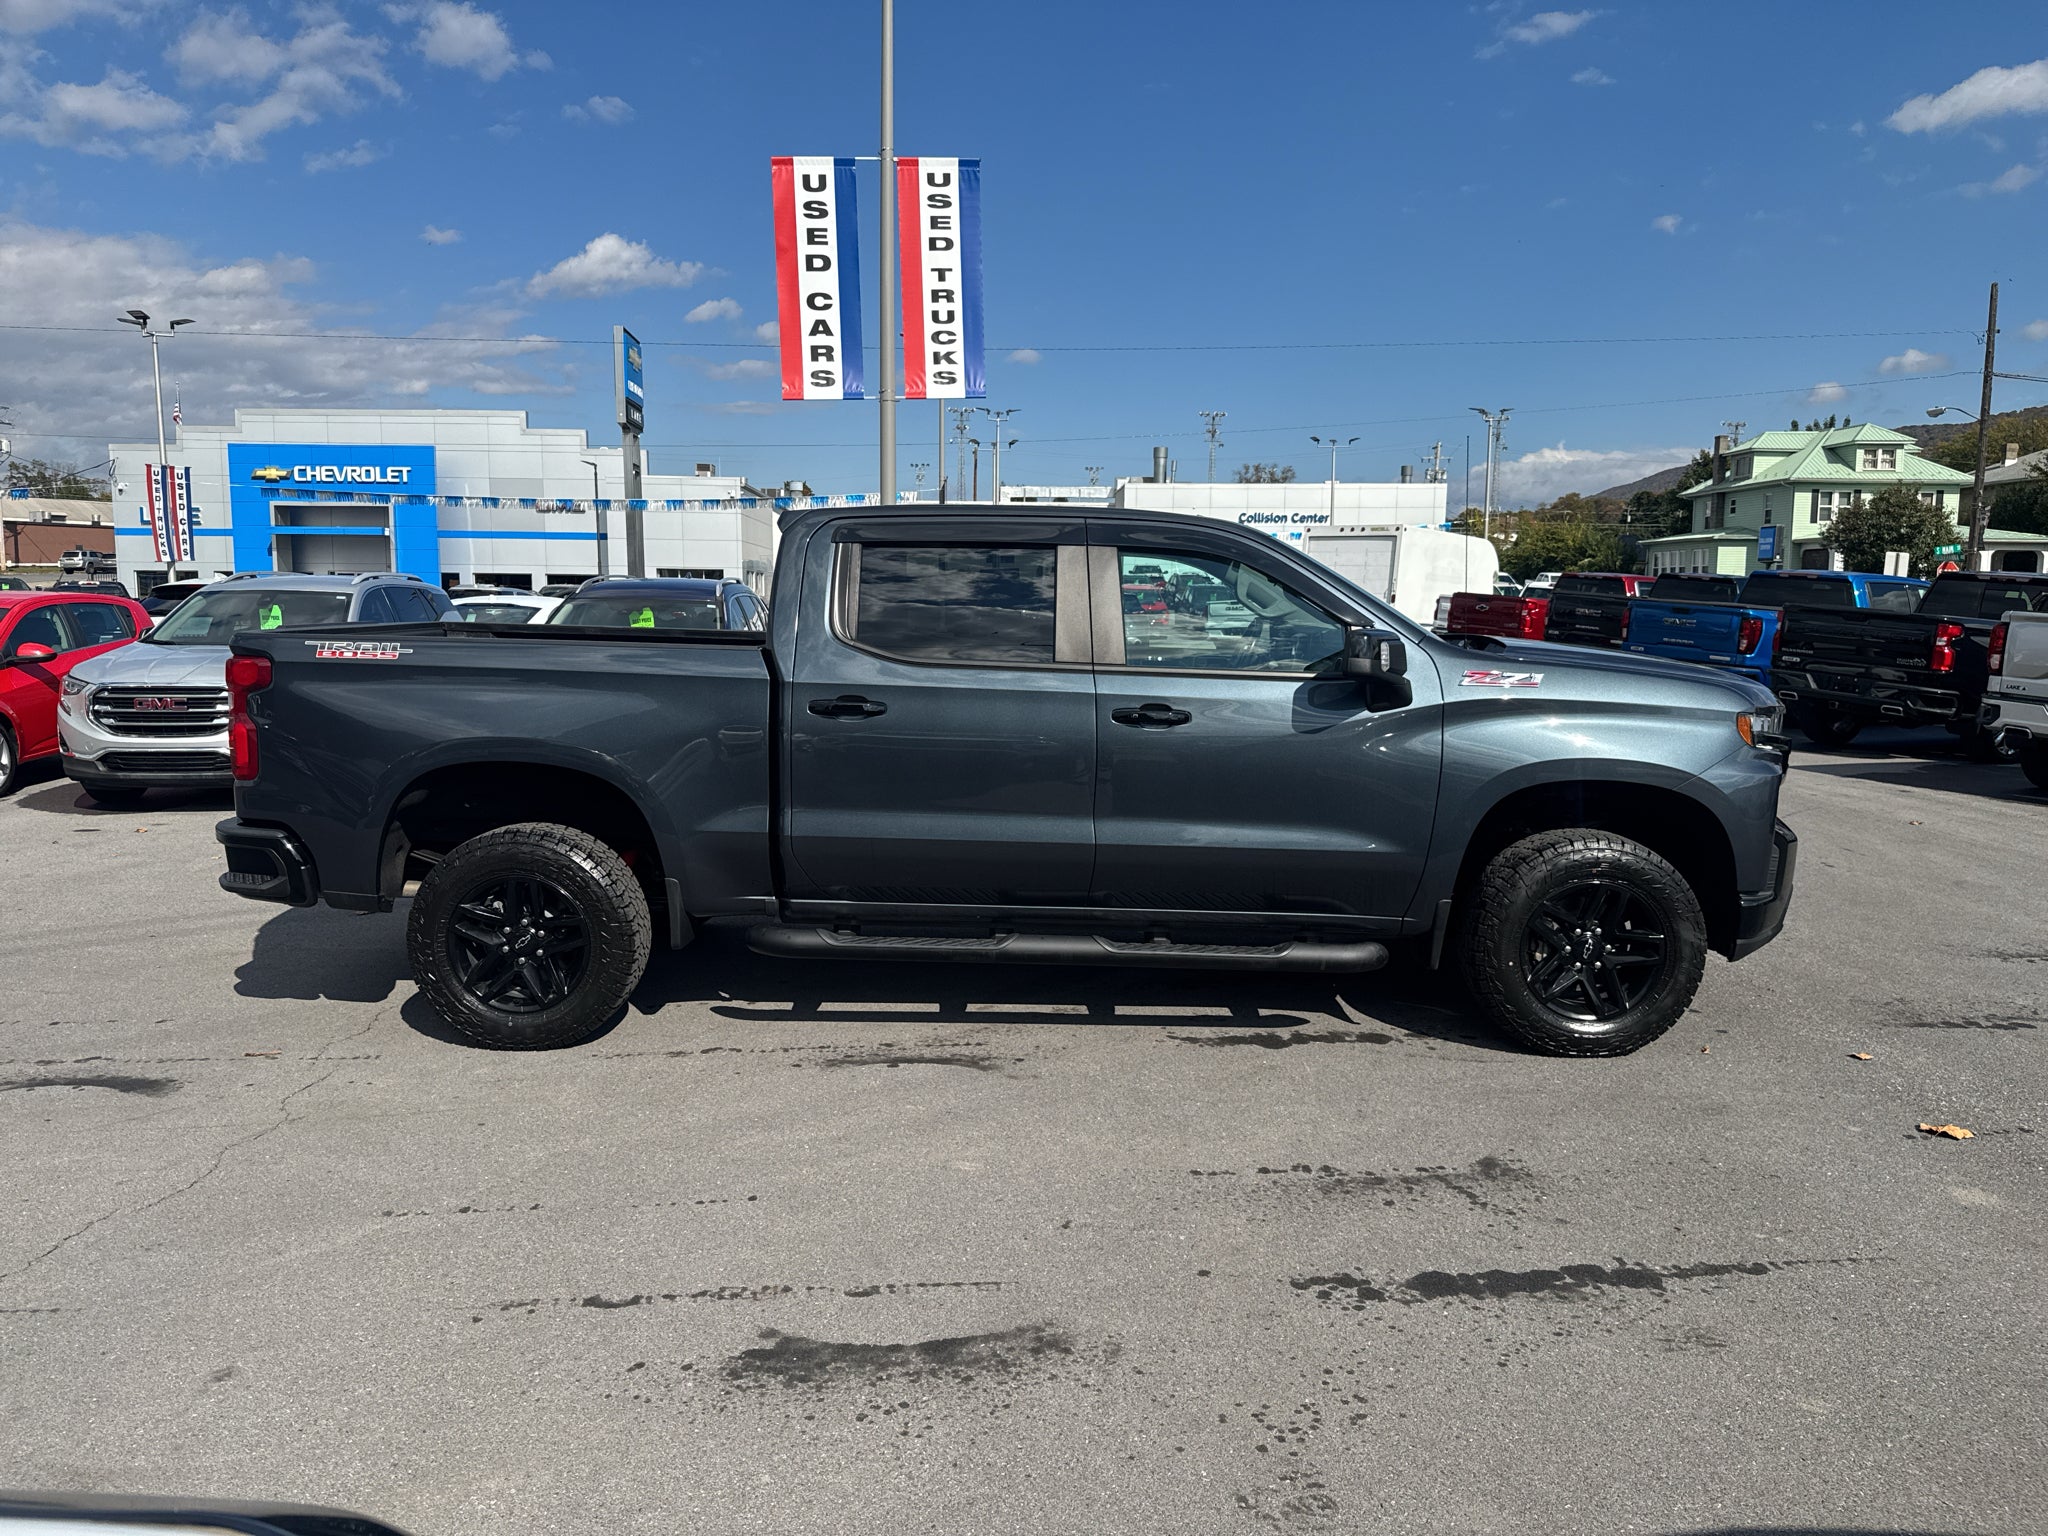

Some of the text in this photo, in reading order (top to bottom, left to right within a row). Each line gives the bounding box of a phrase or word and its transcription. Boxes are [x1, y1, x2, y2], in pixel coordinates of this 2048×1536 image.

[802, 174, 836, 388] USED CARS
[926, 172, 959, 385] USED TRUCKS
[293, 465, 412, 483] CHEVROLET
[153, 470, 168, 556] USED TRUCKS
[176, 472, 189, 556] USED CARS
[1238, 512, 1329, 525] Collision Center
[305, 641, 413, 653] TRAIL
[316, 650, 400, 659] BOSS
[1458, 670, 1545, 688] Z71
[133, 698, 188, 711] GMC
